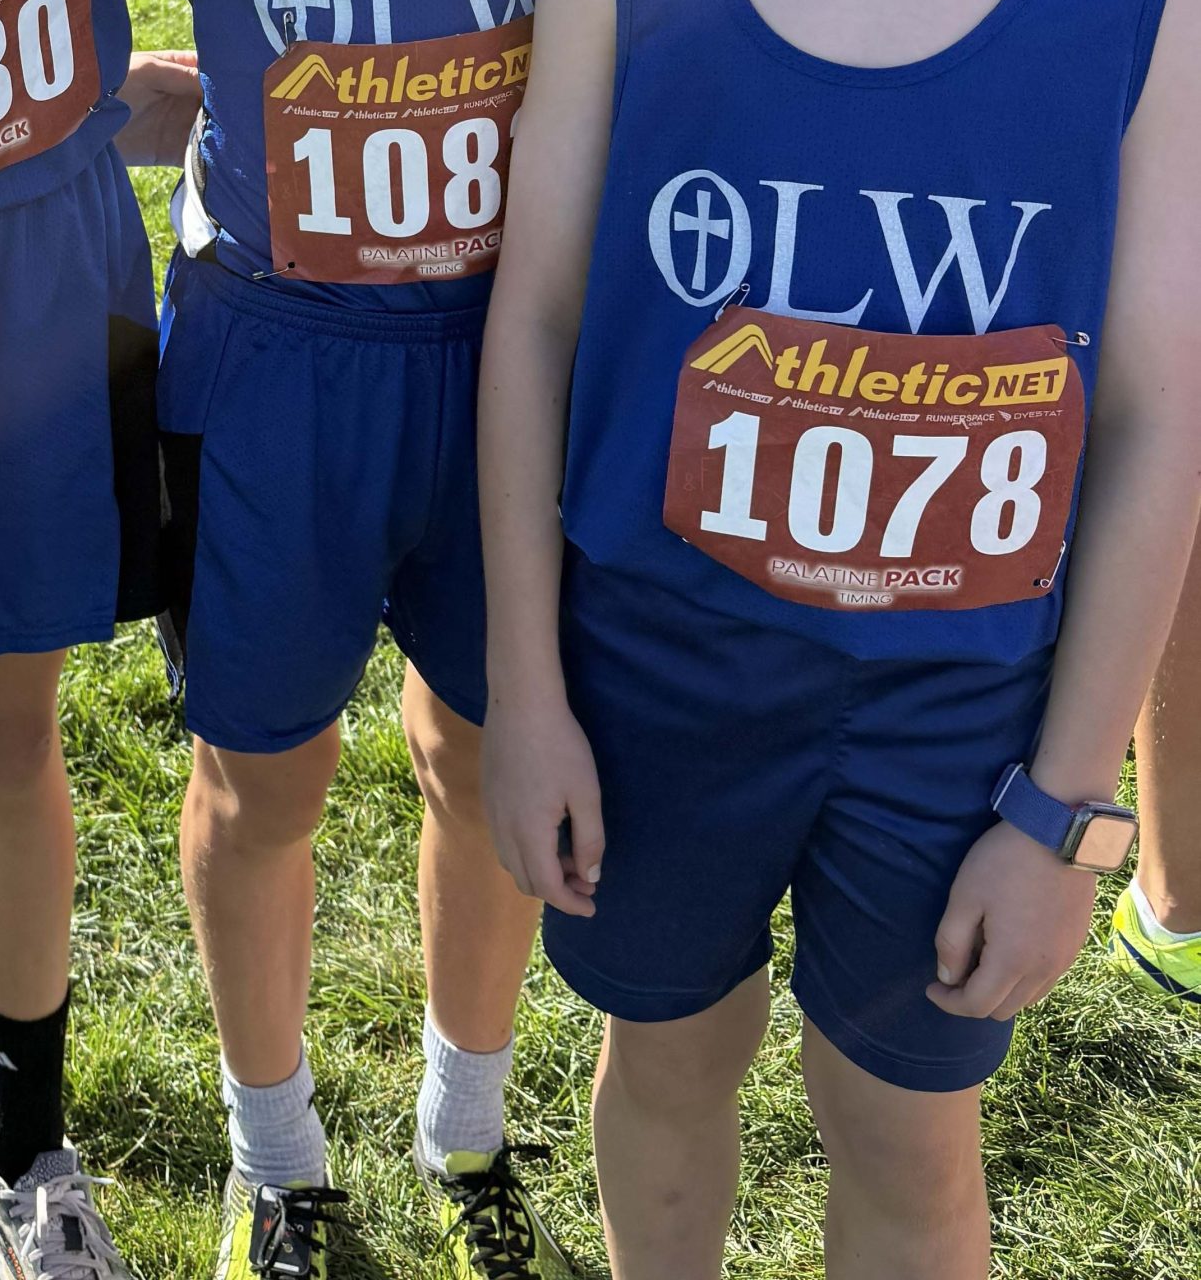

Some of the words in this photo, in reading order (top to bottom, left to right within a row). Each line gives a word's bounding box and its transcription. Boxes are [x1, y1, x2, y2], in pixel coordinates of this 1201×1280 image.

[269, 43, 534, 104] AthleticN
[294, 110, 520, 238] 108
[361, 245, 448, 261] PALATINE
[454, 230, 503, 257] PAC
[648, 169, 1052, 336] OLW
[419, 263, 464, 275] TIMING
[700, 410, 1047, 558] 1078
[771, 559, 878, 587] PALATINE
[884, 568, 960, 587] PACK
[840, 591, 892, 605] TIMING
